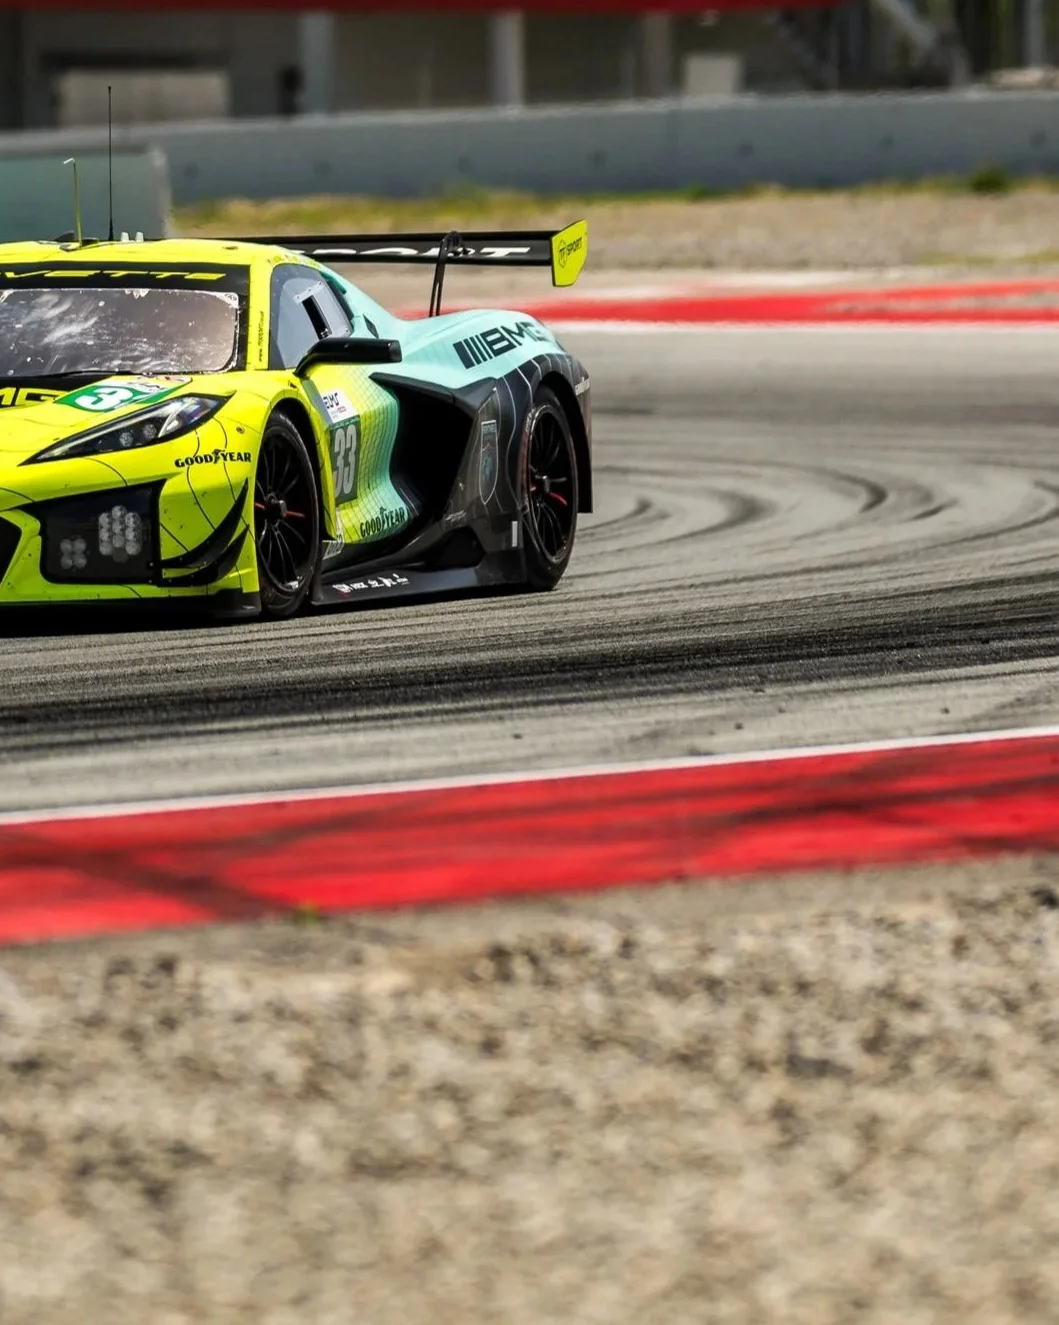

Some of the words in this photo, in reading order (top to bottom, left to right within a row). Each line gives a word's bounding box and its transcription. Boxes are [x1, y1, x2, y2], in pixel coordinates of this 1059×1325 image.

[174, 448, 252, 469] GOODYEAR
[333, 424, 357, 498] 33
[359, 504, 405, 539] GOODYEAR
